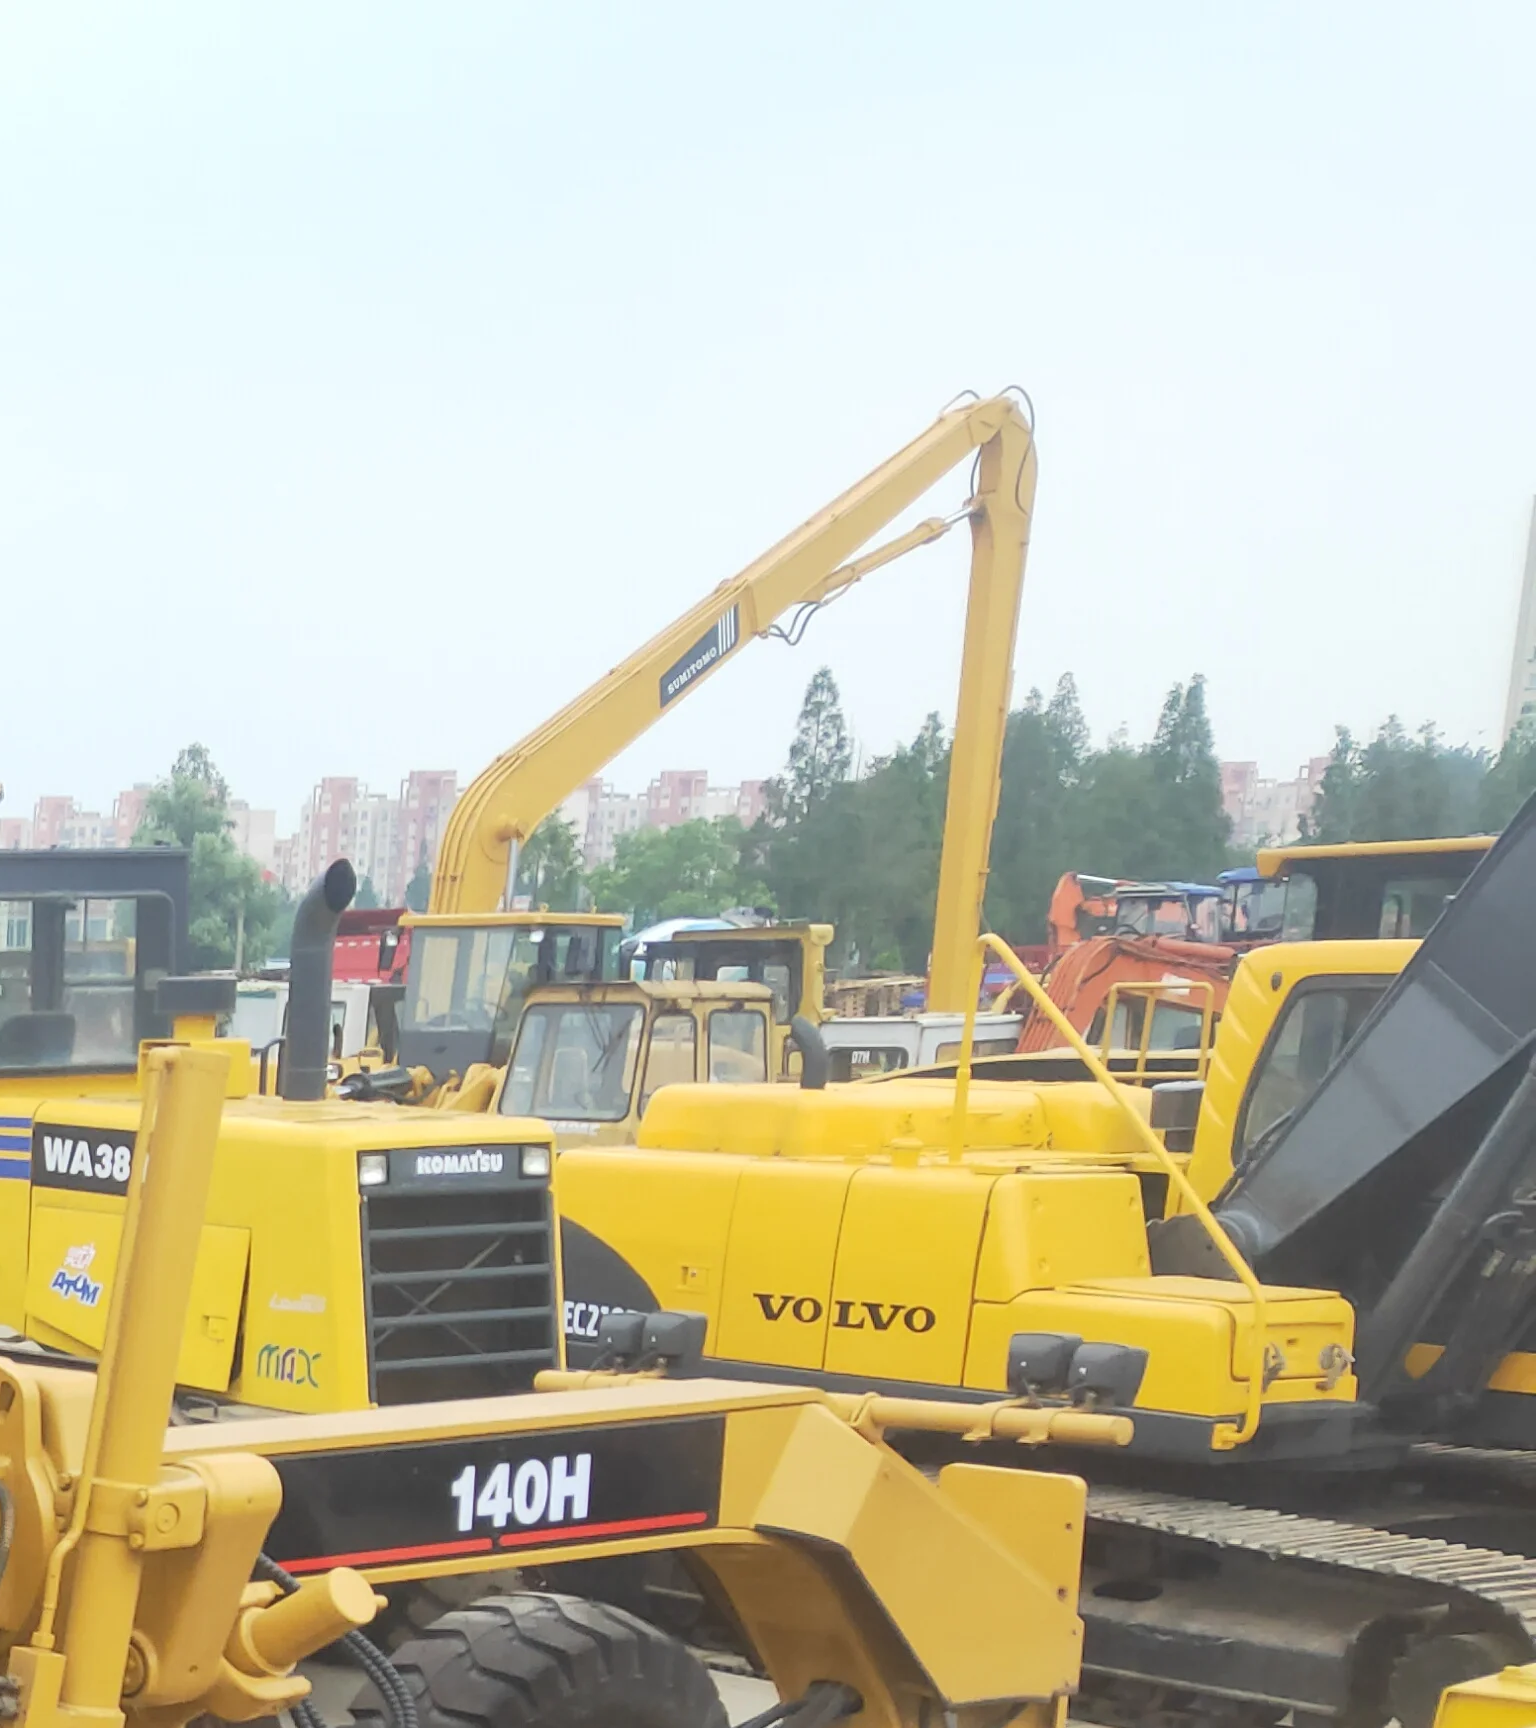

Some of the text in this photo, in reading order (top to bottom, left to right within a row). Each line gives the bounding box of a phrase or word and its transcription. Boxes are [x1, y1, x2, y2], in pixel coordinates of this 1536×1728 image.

[666, 646, 718, 695] SUMITOMO
[416, 1149, 504, 1175] KOMATSU
[752, 1292, 936, 1334] VOLVO
[450, 1453, 592, 1532] 140H
